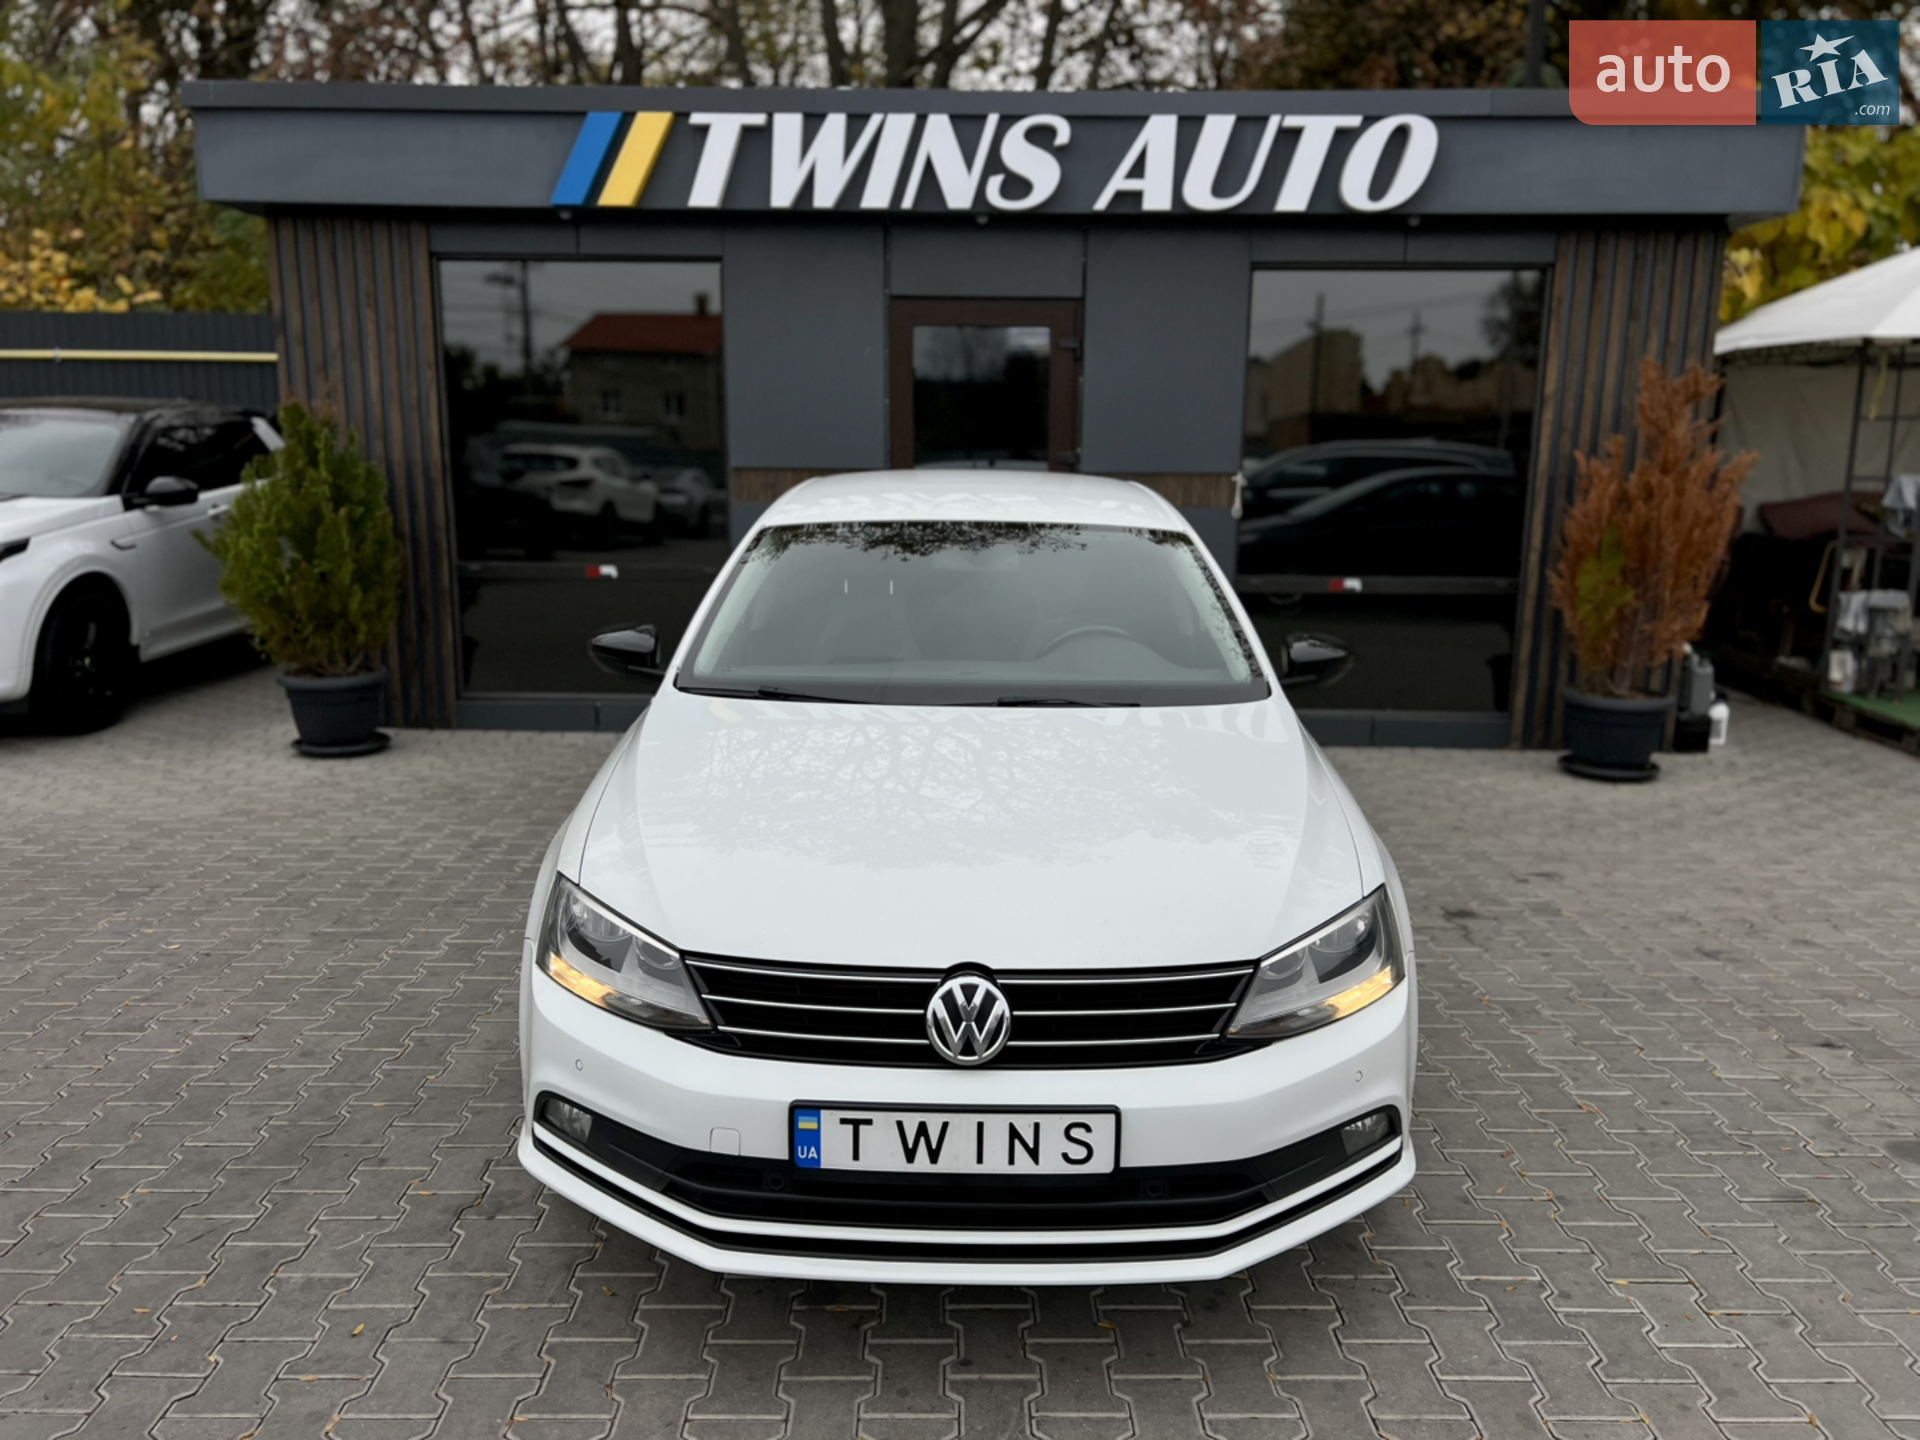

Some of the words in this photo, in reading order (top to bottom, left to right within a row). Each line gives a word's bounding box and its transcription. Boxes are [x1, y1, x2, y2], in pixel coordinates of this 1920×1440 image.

[687, 111, 1072, 212] TWINS
[1092, 113, 1440, 213] AUTO
[797, 1145, 819, 1160] UA
